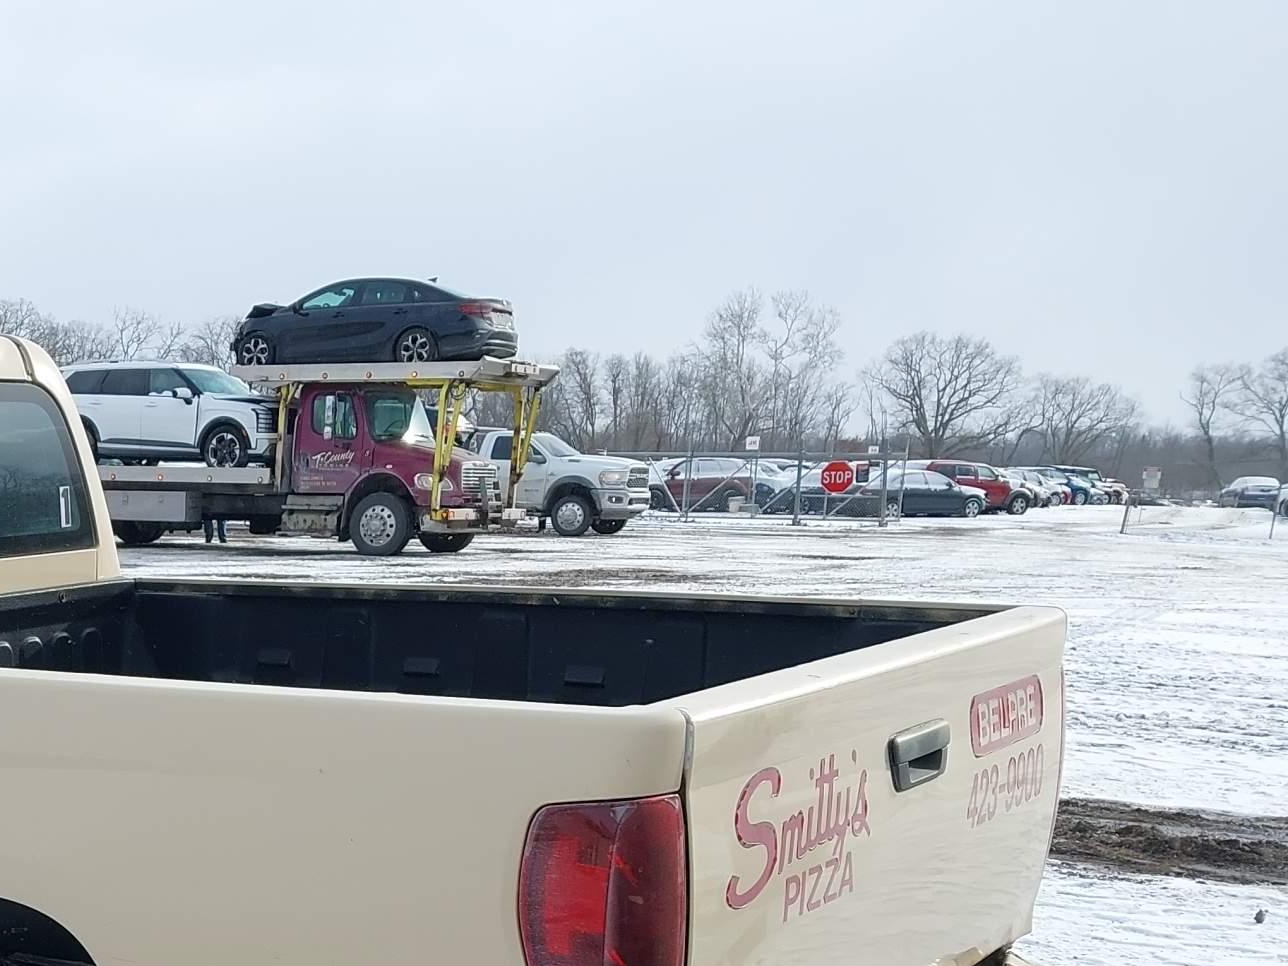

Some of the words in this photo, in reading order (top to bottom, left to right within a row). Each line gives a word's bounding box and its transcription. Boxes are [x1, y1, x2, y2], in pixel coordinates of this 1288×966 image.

[823, 470, 852, 484] STOP
[978, 684, 1037, 747] BELPRE
[967, 743, 1044, 829] 423-9900
[726, 749, 871, 910] Smitty's
[782, 851, 855, 924] PIZZA
